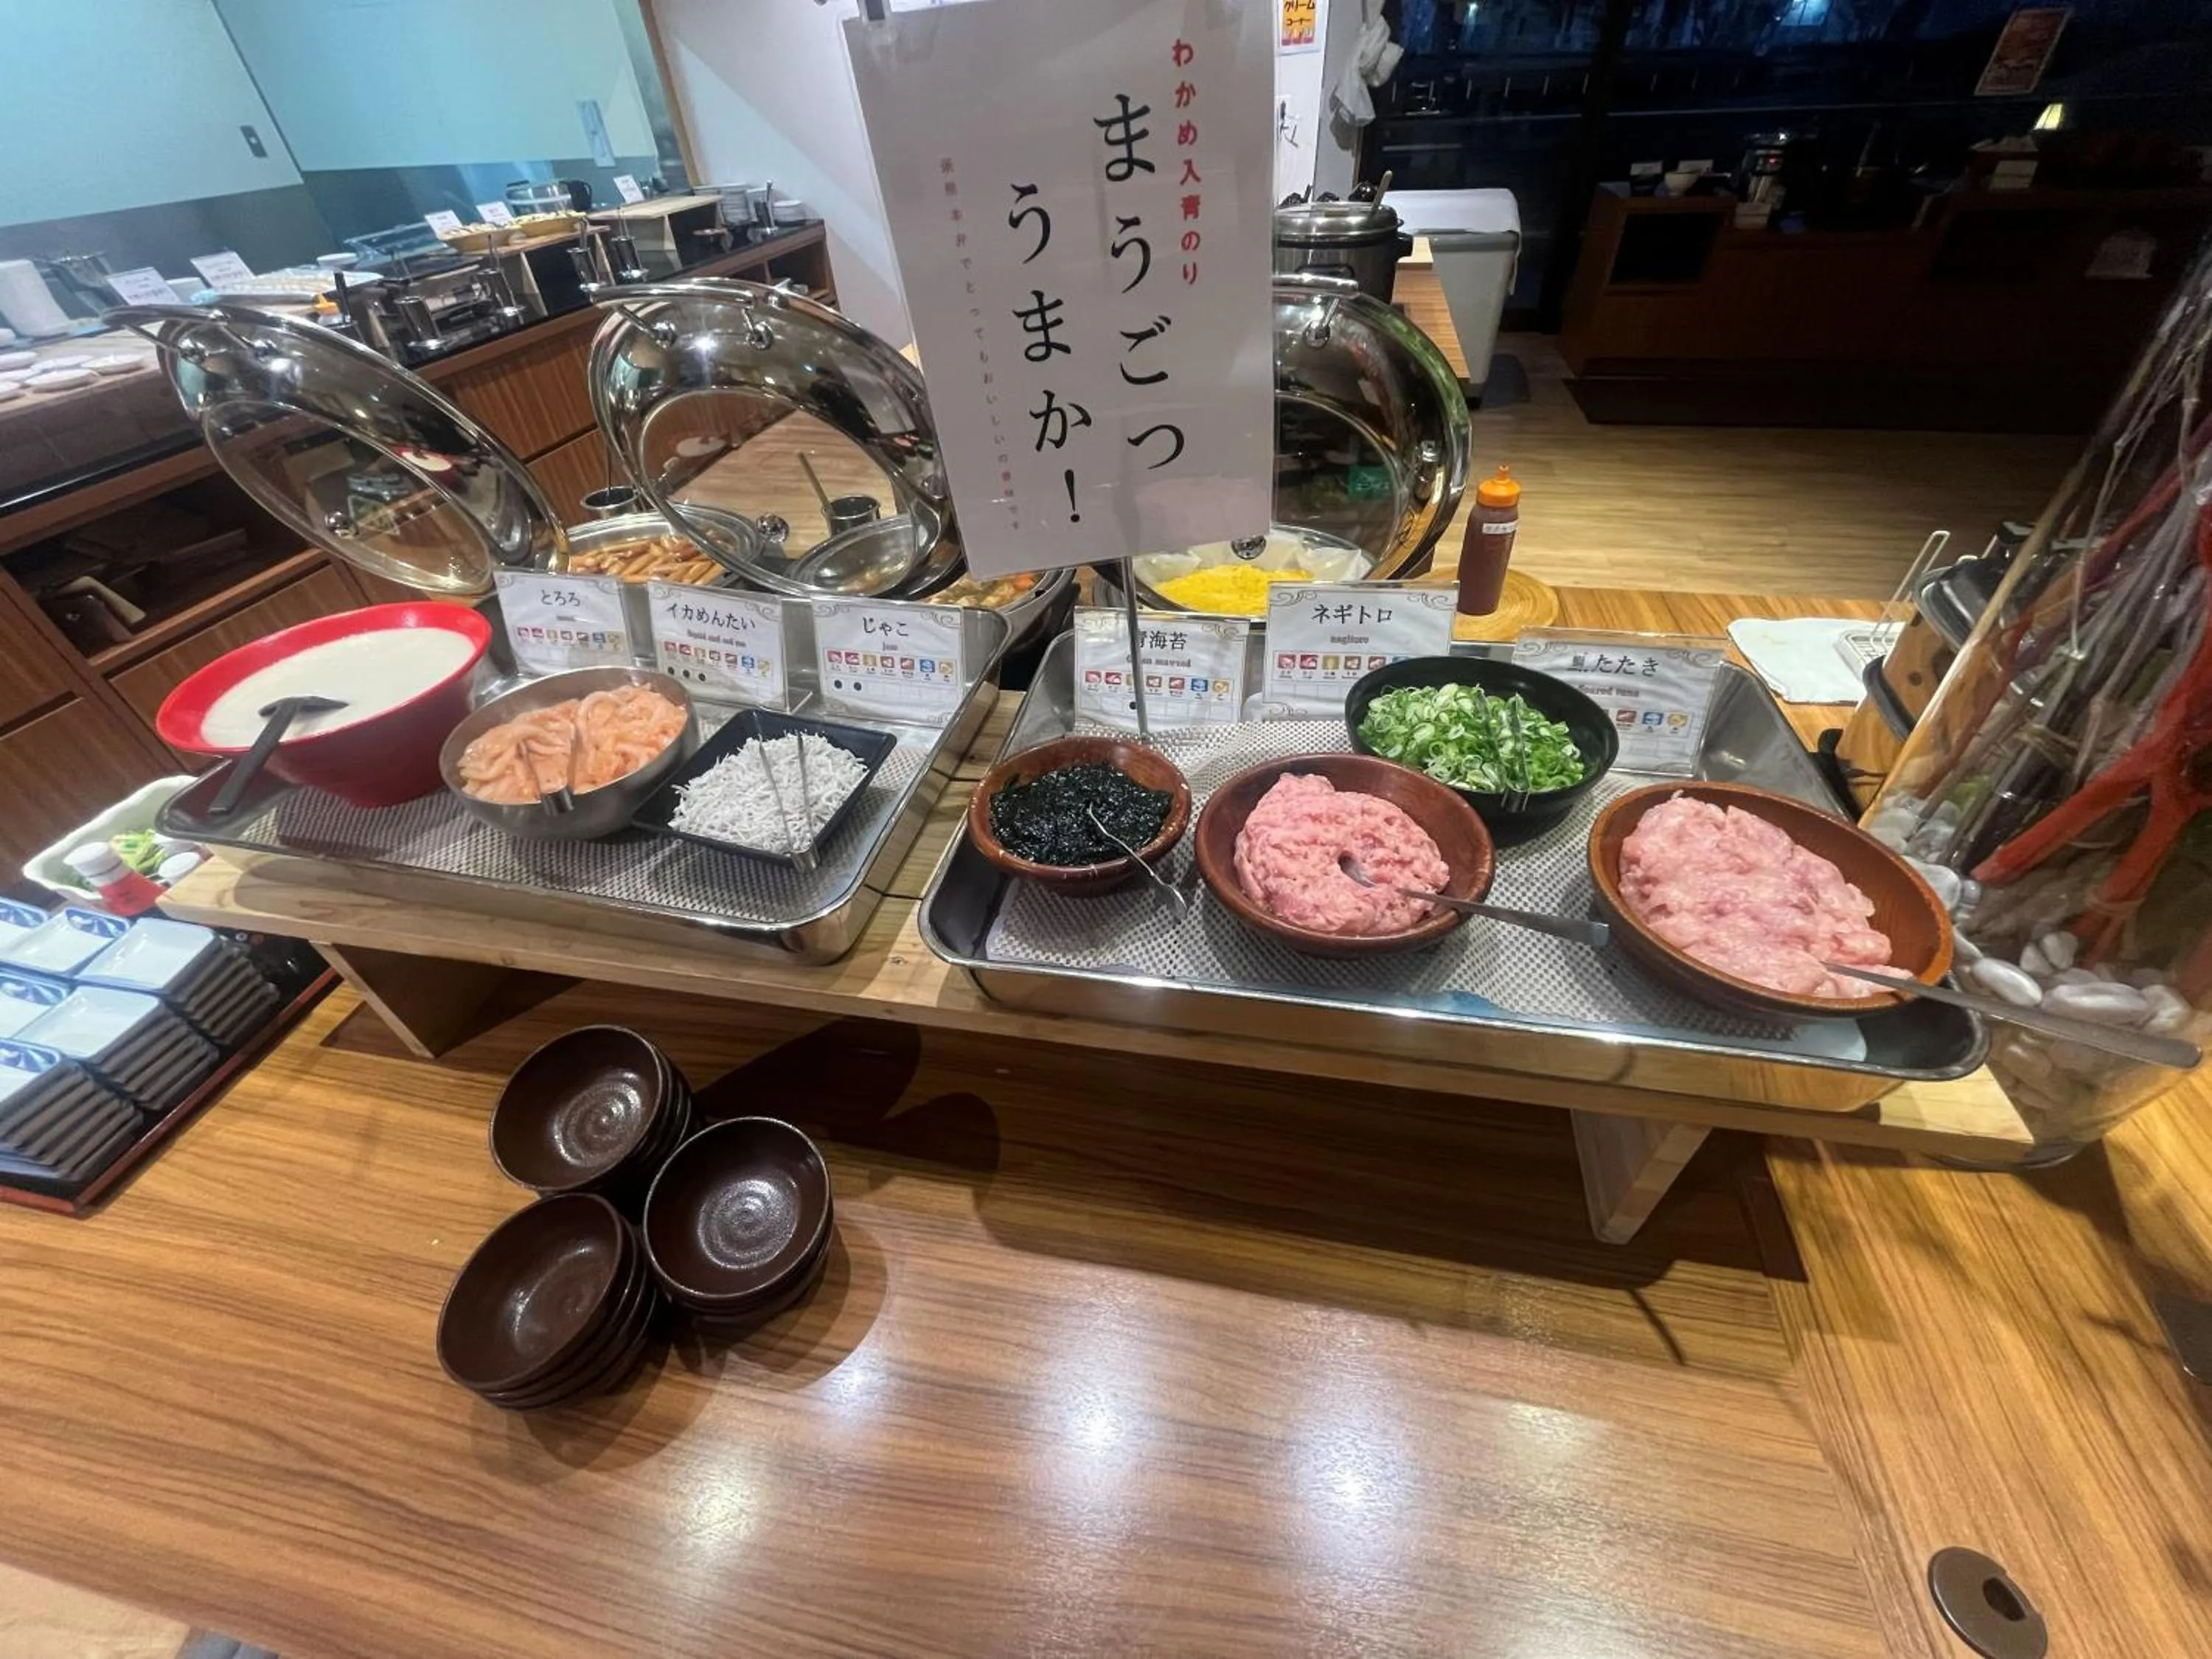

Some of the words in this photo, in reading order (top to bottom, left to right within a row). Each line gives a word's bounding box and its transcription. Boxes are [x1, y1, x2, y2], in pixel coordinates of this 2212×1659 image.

[1172, 38, 1202, 285] わかめ入青のり
[1093, 93, 1185, 470] まうごつ
[540, 589, 581, 607] とろろ
[666, 602, 757, 631] イカめんたい
[862, 616, 910, 636] じゃこ
[1311, 603, 1394, 625] ネギトロ
[1569, 653, 1659, 678] たたき
